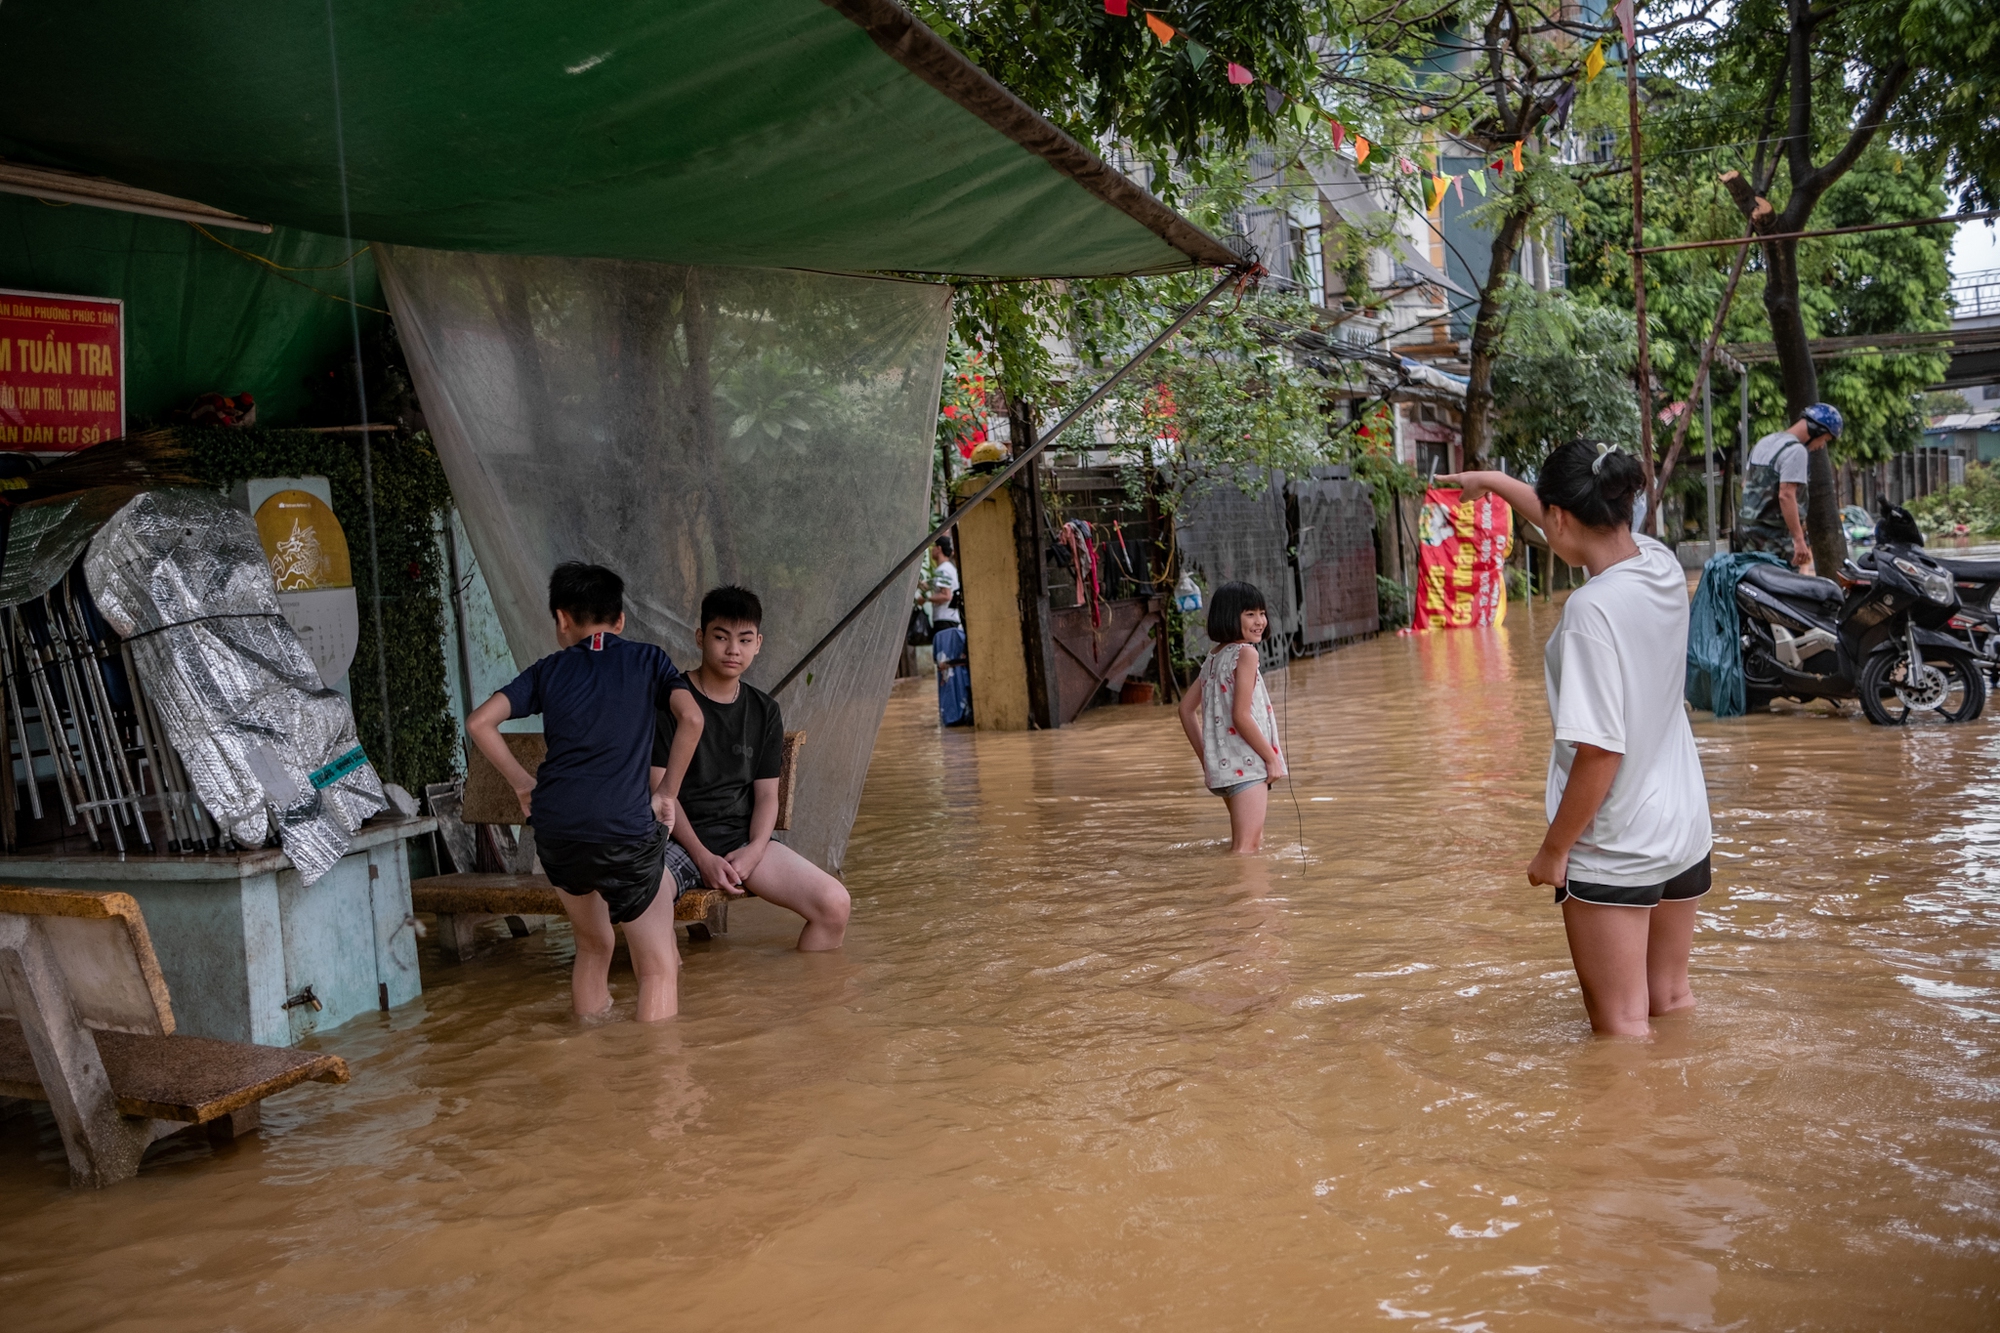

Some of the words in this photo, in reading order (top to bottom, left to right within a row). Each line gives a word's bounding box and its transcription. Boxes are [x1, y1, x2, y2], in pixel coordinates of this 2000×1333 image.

[13, 302, 32, 318] DÂN
[34, 303, 71, 321] PHƯỜNG
[72, 307, 96, 323] PHÚC
[97, 309, 114, 325] TÂN
[17, 329, 72, 375] TUẦN
[77, 342, 114, 377] TRA
[18, 386, 40, 415] TẠM
[42, 383, 65, 414] TRÚ,
[67, 388, 88, 416] TẠM
[91, 381, 116, 413] VẮNG
[23, 423, 54, 443] DÂN
[58, 424, 79, 444] CƯ
[81, 421, 101, 445] SỐ
[104, 428, 111, 441] 1
[1452, 542, 1478, 586] Nhập
[1424, 564, 1446, 611] Miến
[1451, 590, 1474, 625] Cây
